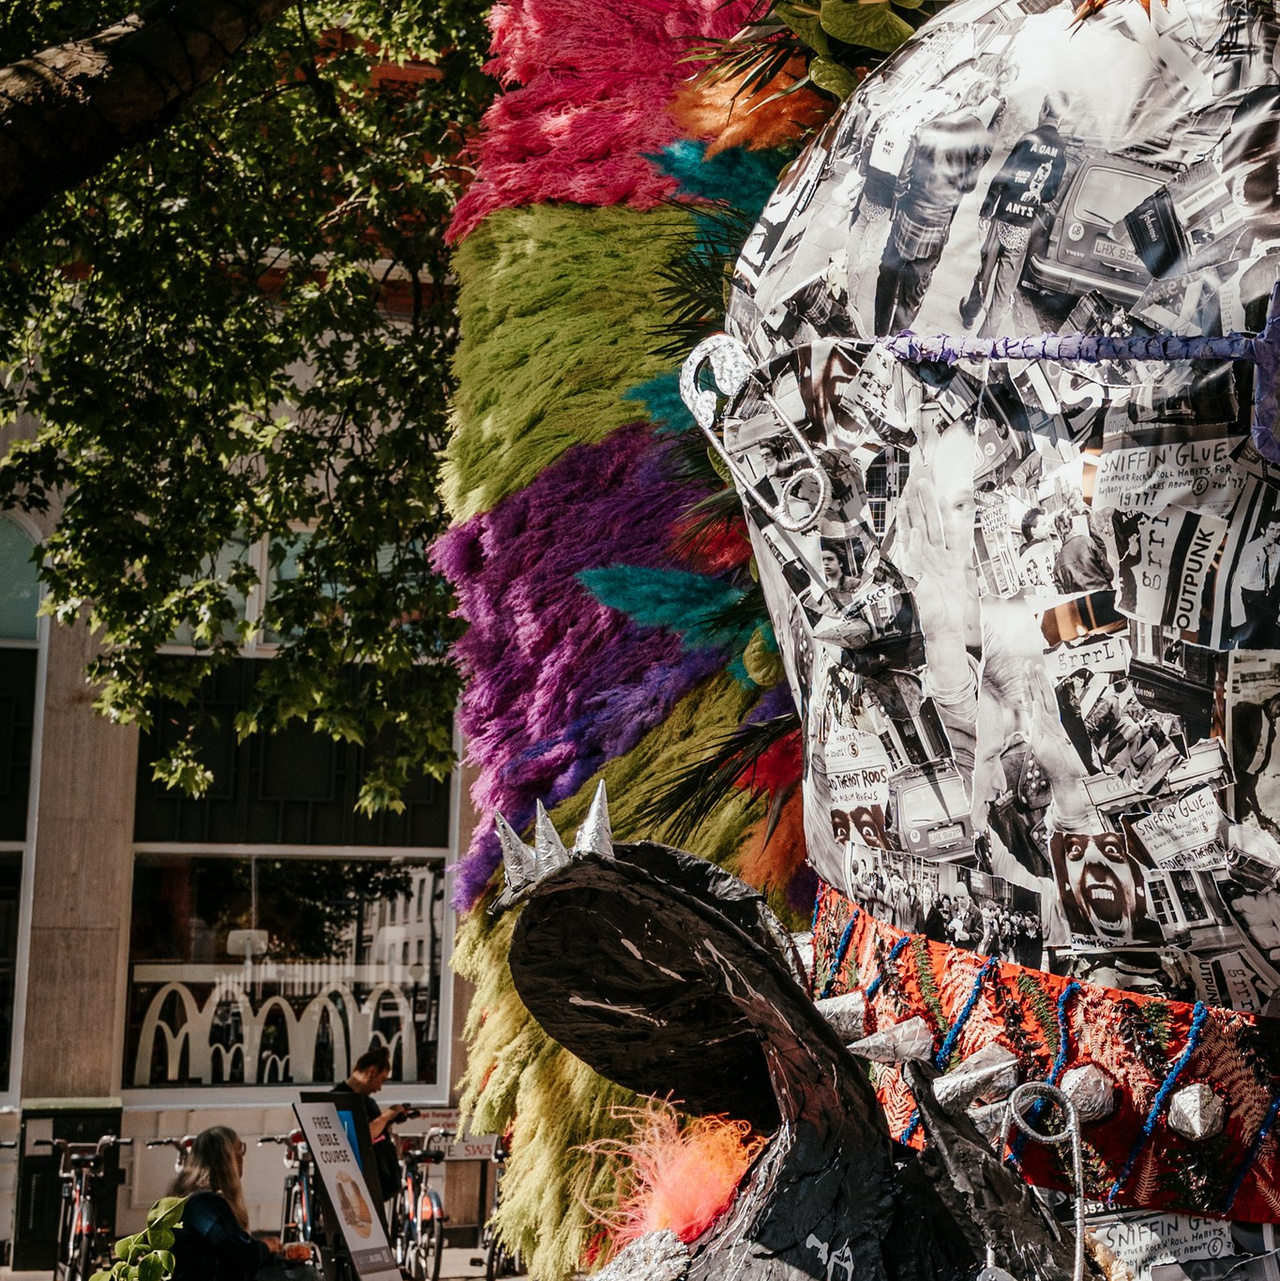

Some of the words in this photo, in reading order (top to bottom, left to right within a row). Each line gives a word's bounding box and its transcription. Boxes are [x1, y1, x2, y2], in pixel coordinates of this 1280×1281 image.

[1005, 201, 1035, 218] ANTS
[1096, 241, 1117, 258] LHX
[1101, 444, 1172, 473] SNIFFIN'
[1214, 463, 1233, 474] FOR
[1168, 480, 1193, 488] ABOUT
[1119, 491, 1158, 506] 1977!
[983, 507, 1004, 521] WINE
[1176, 527, 1215, 630] OUTPUNK
[312, 1116, 332, 1129] FREE
[317, 1133, 340, 1146] BIBLE
[320, 1149, 351, 1164] COURSE
[464, 1143, 493, 1157] SW3
[1191, 1228, 1226, 1241] HABITS,
[1183, 1244, 1208, 1255] ABOUT
